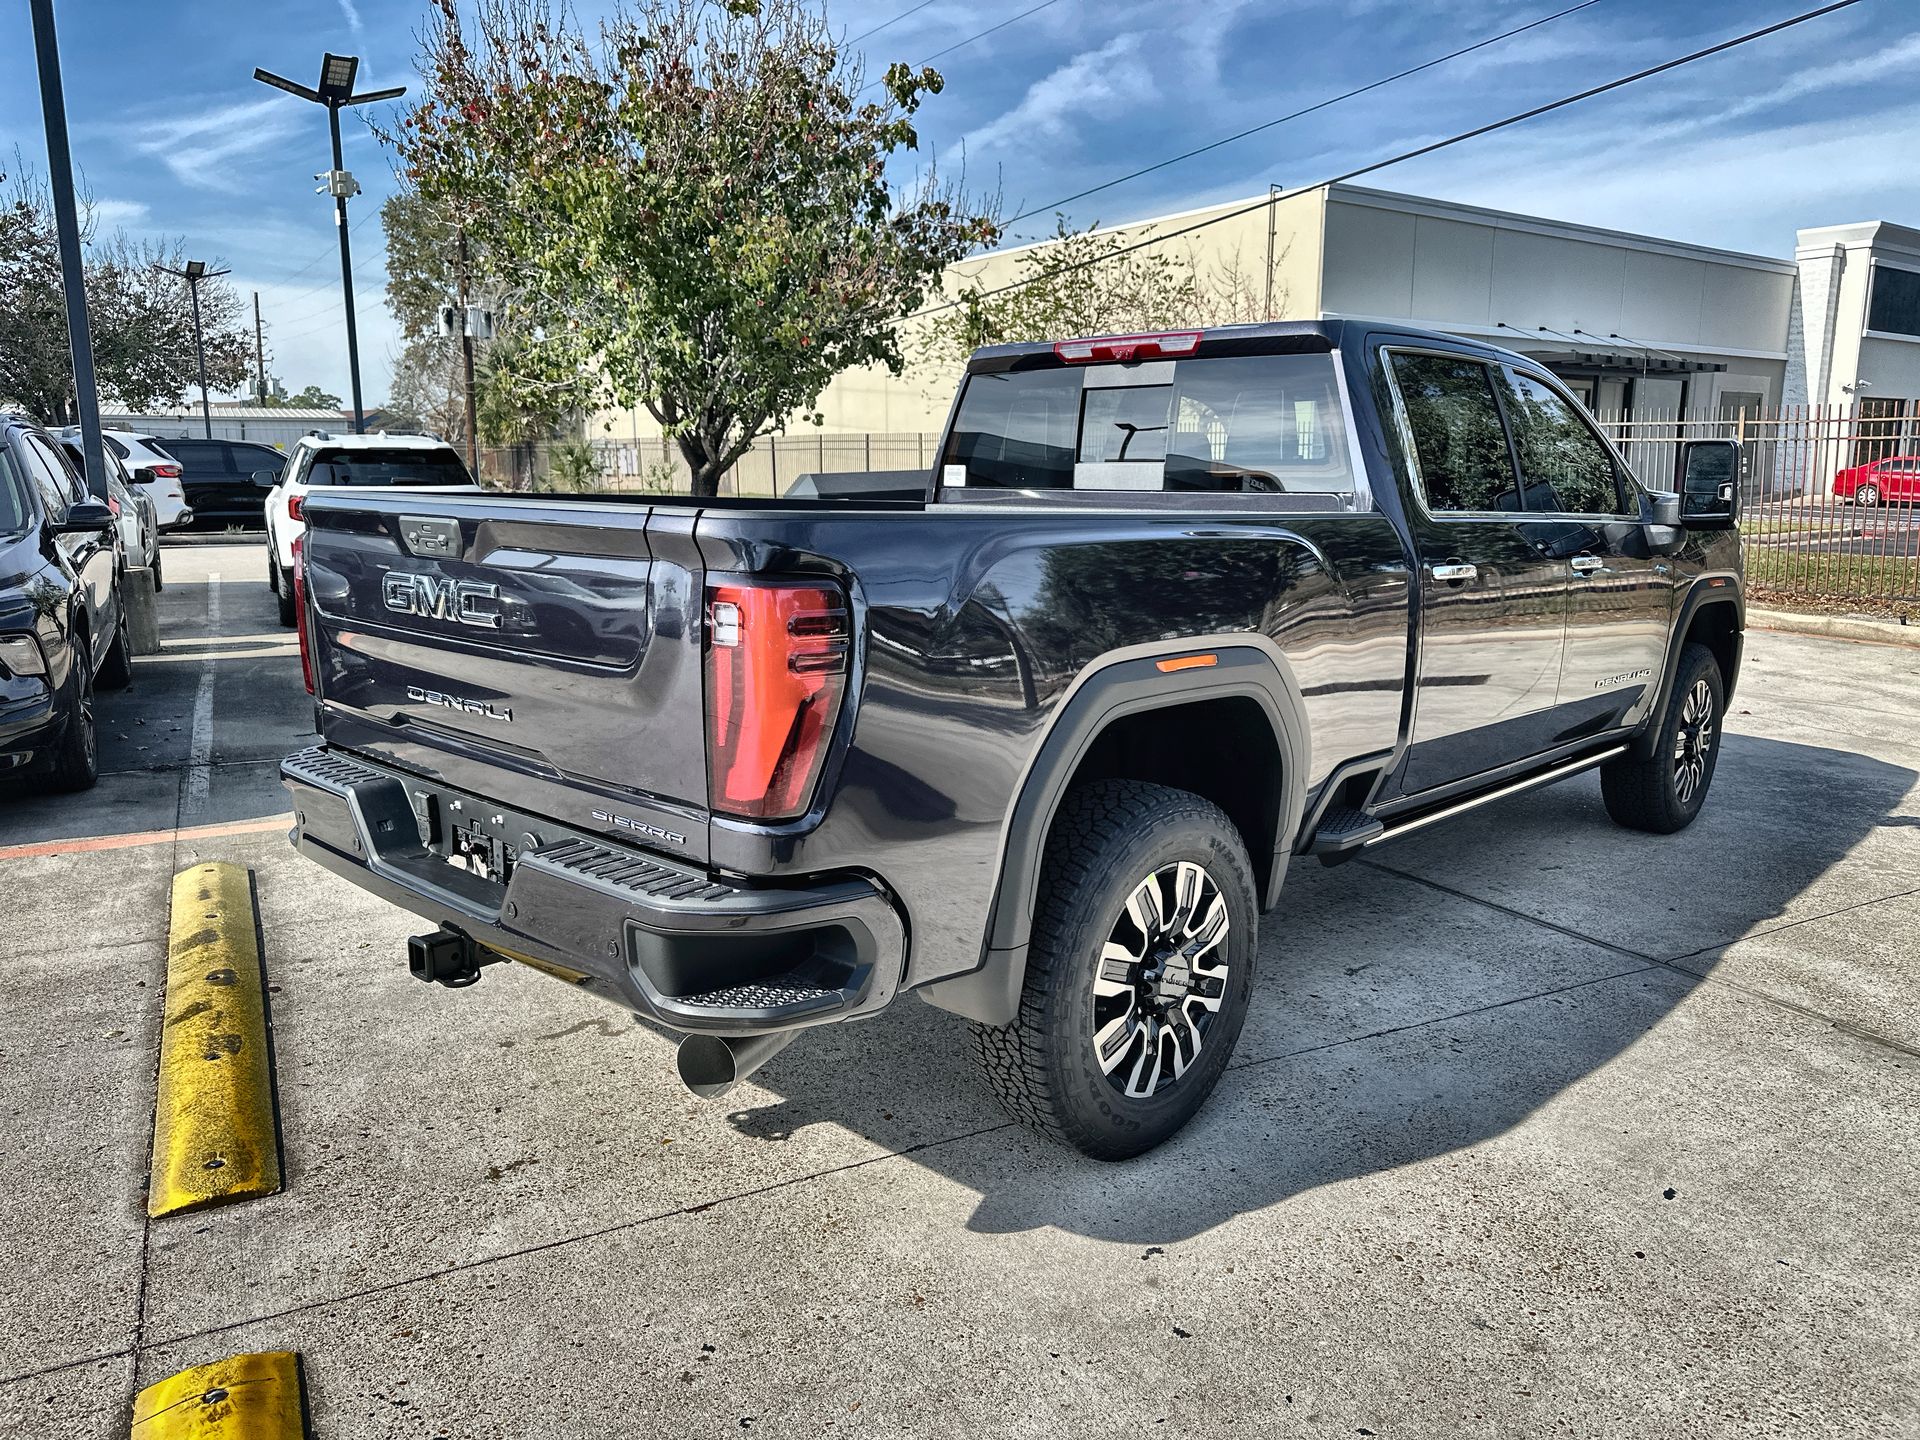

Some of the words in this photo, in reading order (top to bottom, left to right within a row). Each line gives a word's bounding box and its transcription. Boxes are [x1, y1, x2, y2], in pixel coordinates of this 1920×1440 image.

[382, 571, 503, 628] GMC
[1594, 672, 1637, 688] DENALI
[1637, 669, 1651, 679] HD
[407, 686, 513, 722] DENALI
[592, 808, 686, 844] SIERRA
